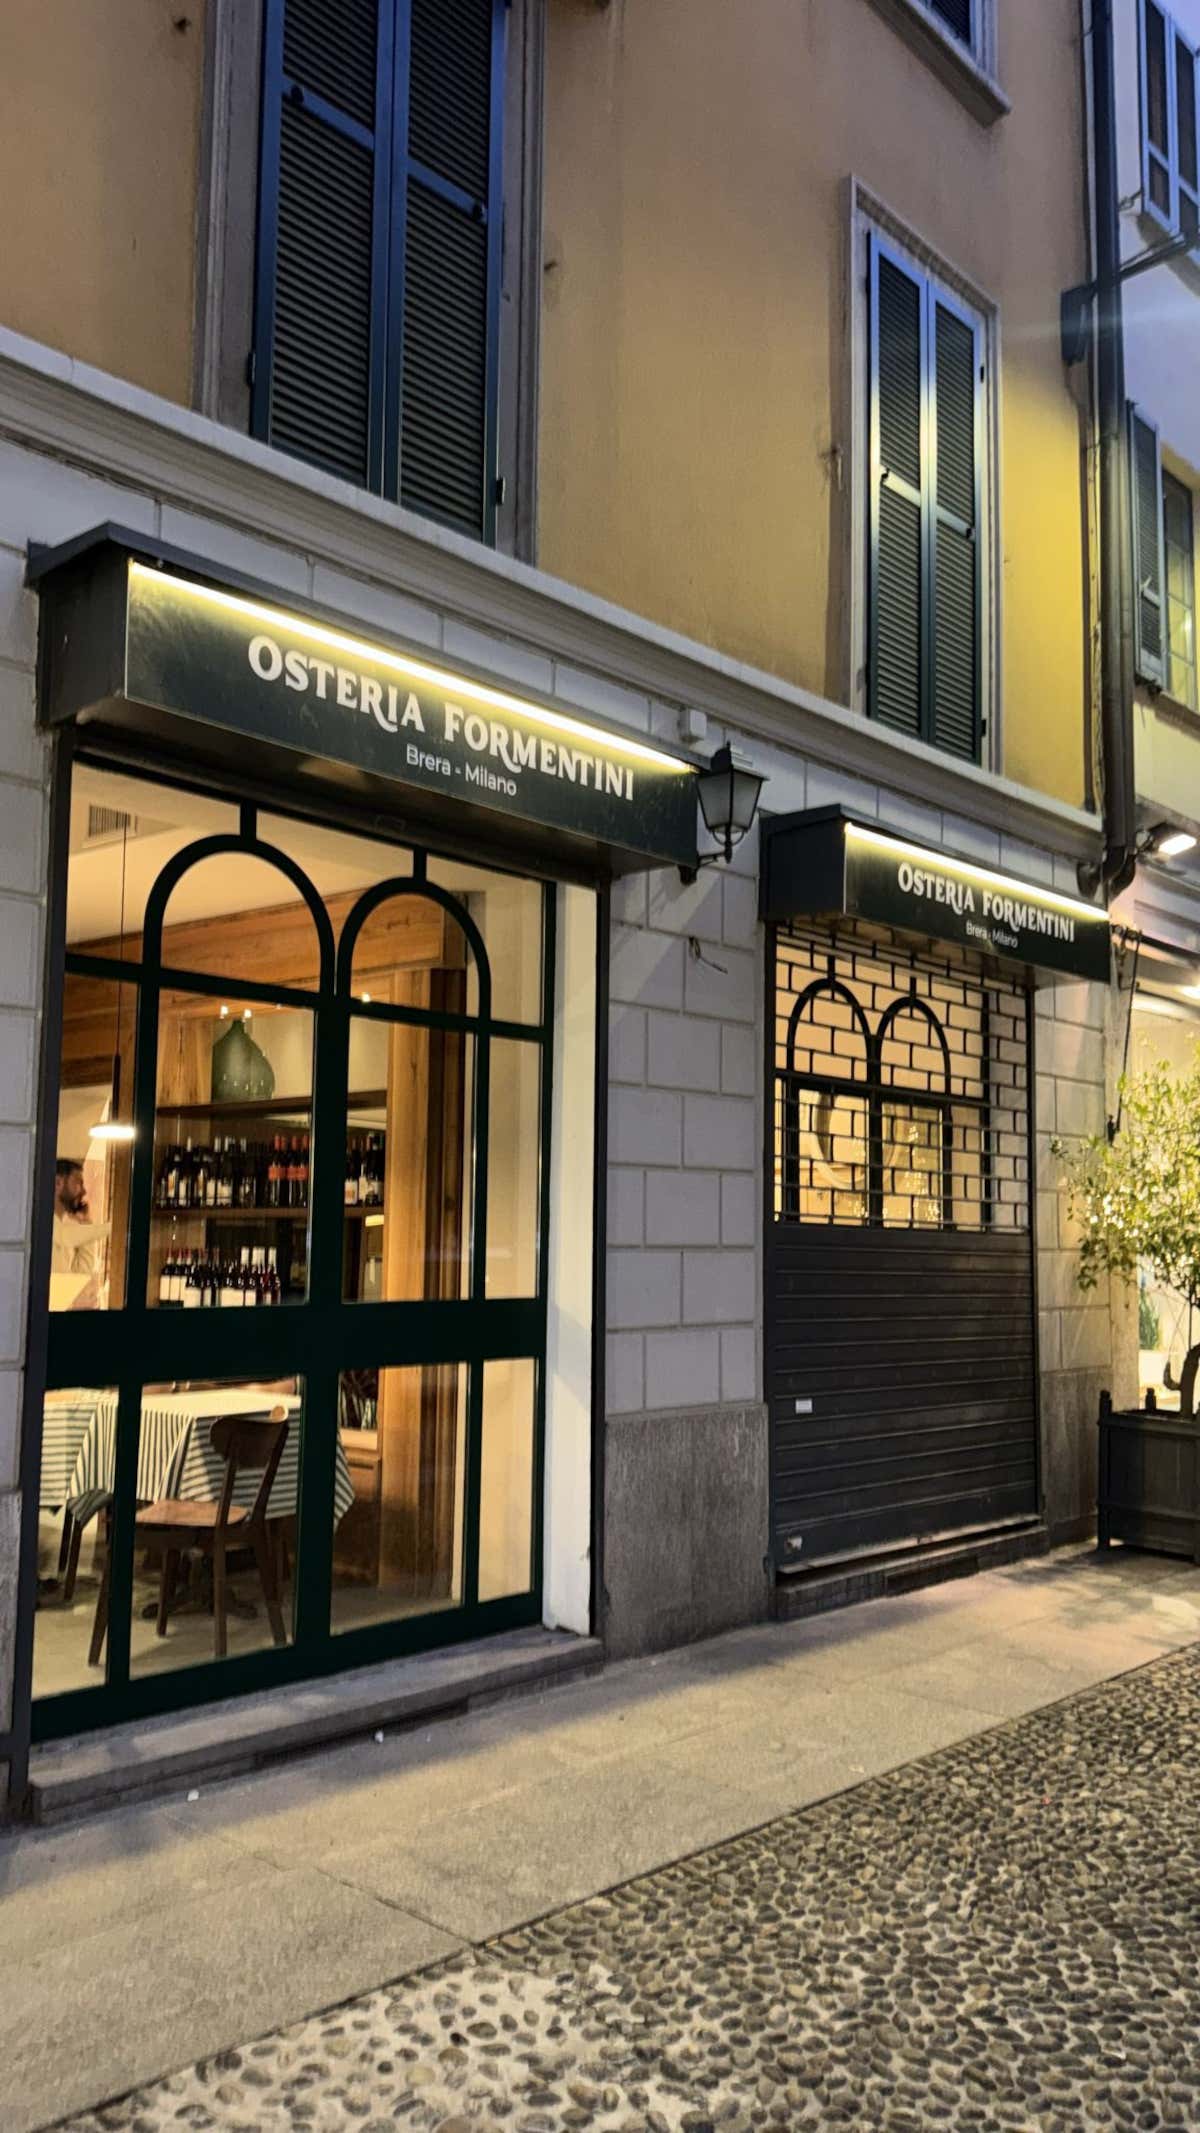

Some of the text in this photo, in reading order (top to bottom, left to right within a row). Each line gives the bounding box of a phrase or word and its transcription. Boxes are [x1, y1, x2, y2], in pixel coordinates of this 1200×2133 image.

[248, 635, 635, 801] OSTERIA FORMENTINI
[406, 743, 451, 777] Brera
[465, 762, 517, 797] Milano
[898, 862, 1075, 943] OSTERIA FORMENTINI
[966, 920, 987, 939] Brera
[992, 928, 1019, 949] Milano
